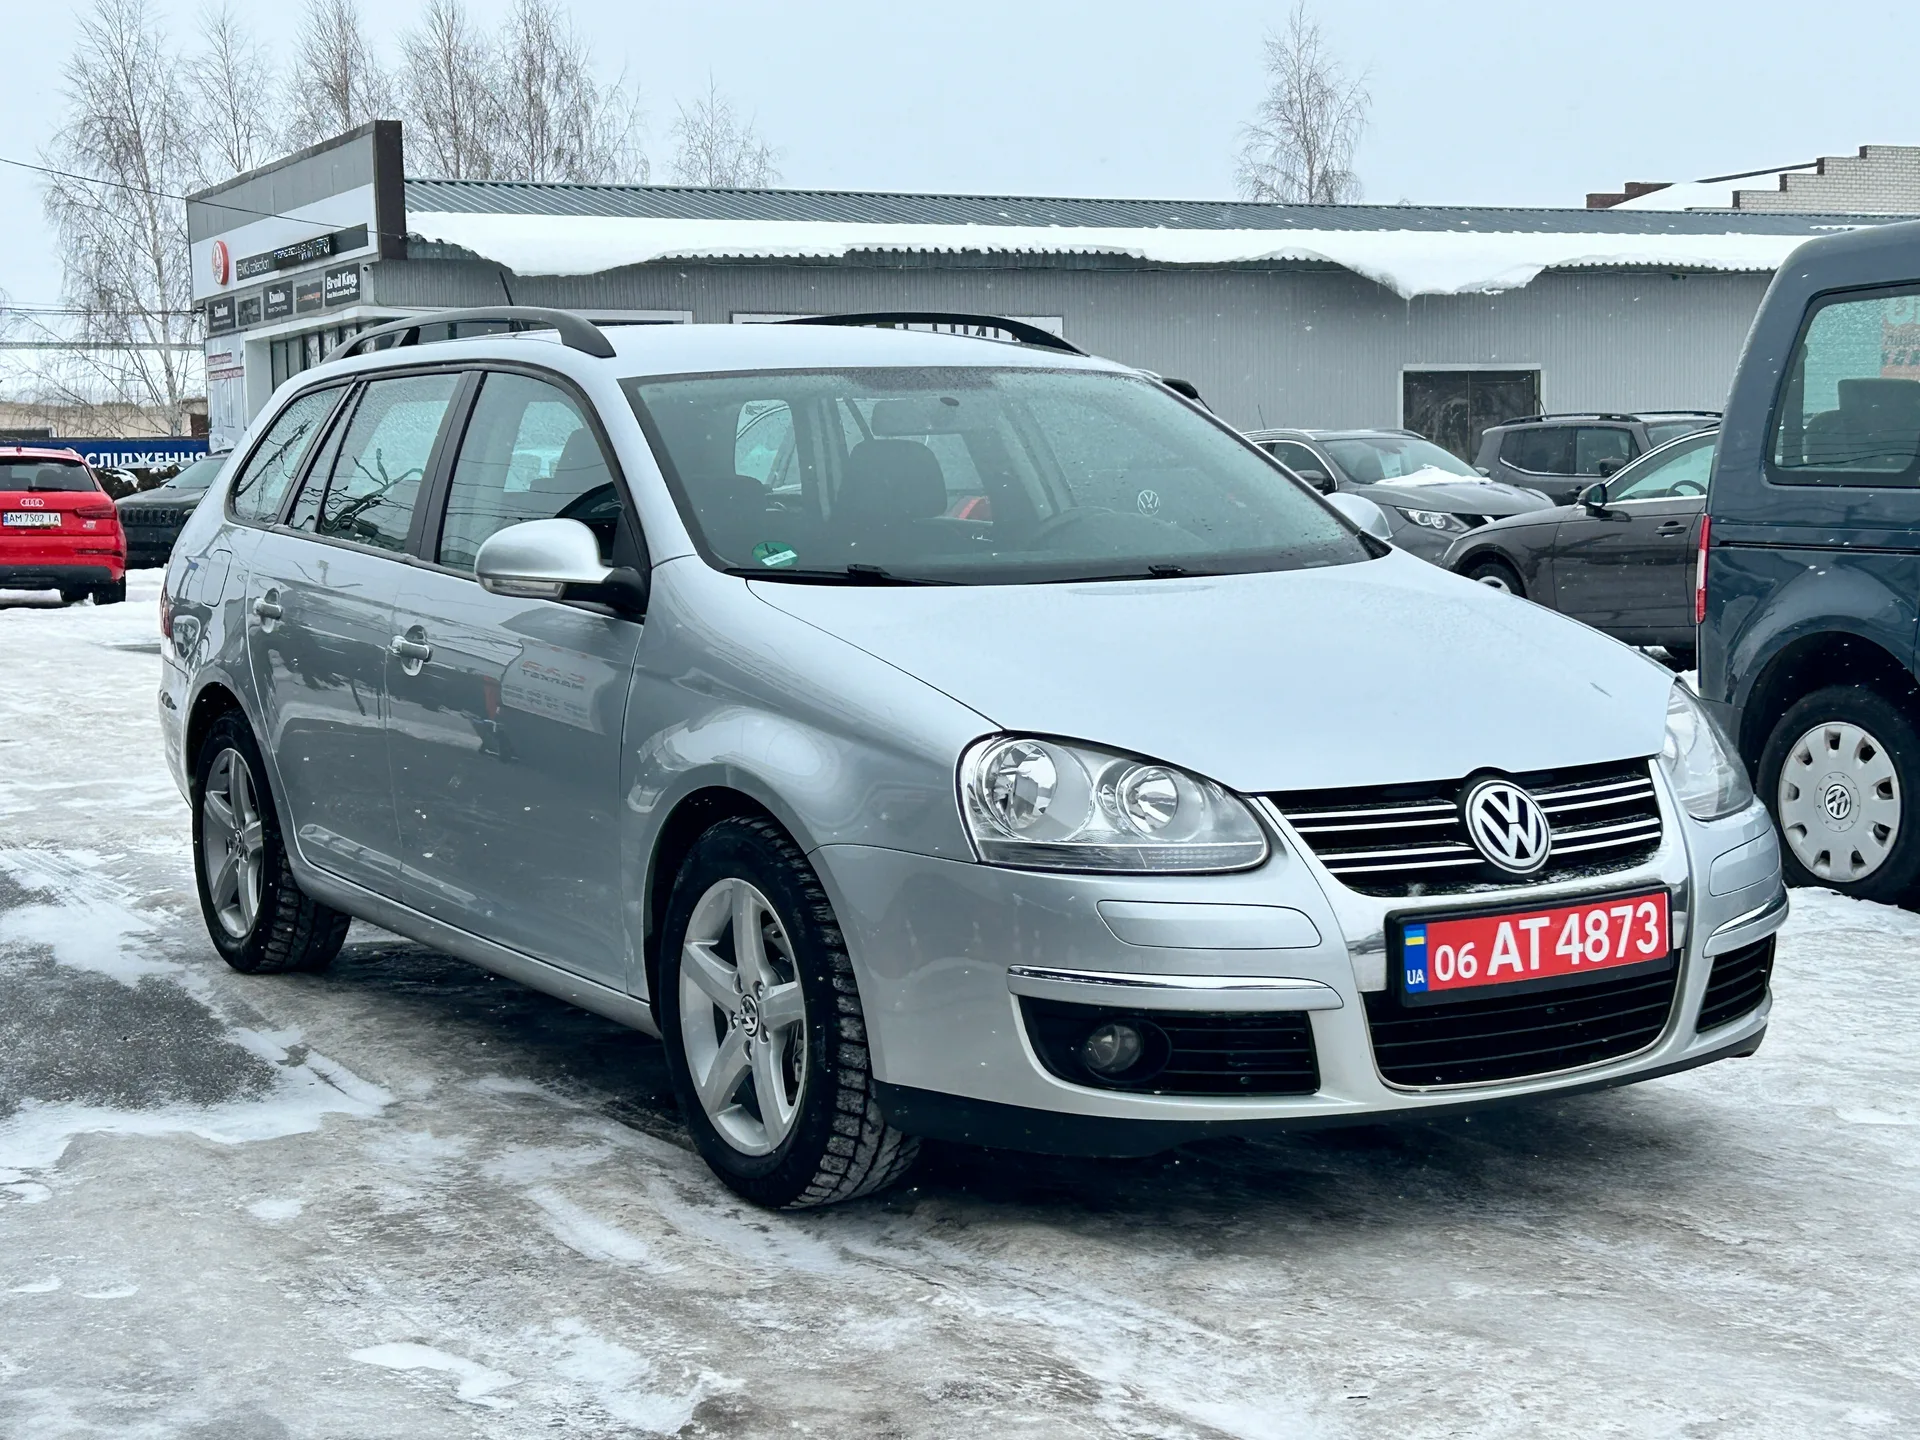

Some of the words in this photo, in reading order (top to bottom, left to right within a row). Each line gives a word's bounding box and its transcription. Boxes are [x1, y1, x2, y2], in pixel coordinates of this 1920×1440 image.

[9, 513, 23, 523] AM
[24, 513, 44, 523] 7502
[1434, 942, 1478, 982] 06
[1486, 916, 1551, 976] AT
[1555, 901, 1660, 965] 4873
[1406, 968, 1425, 985] UA
